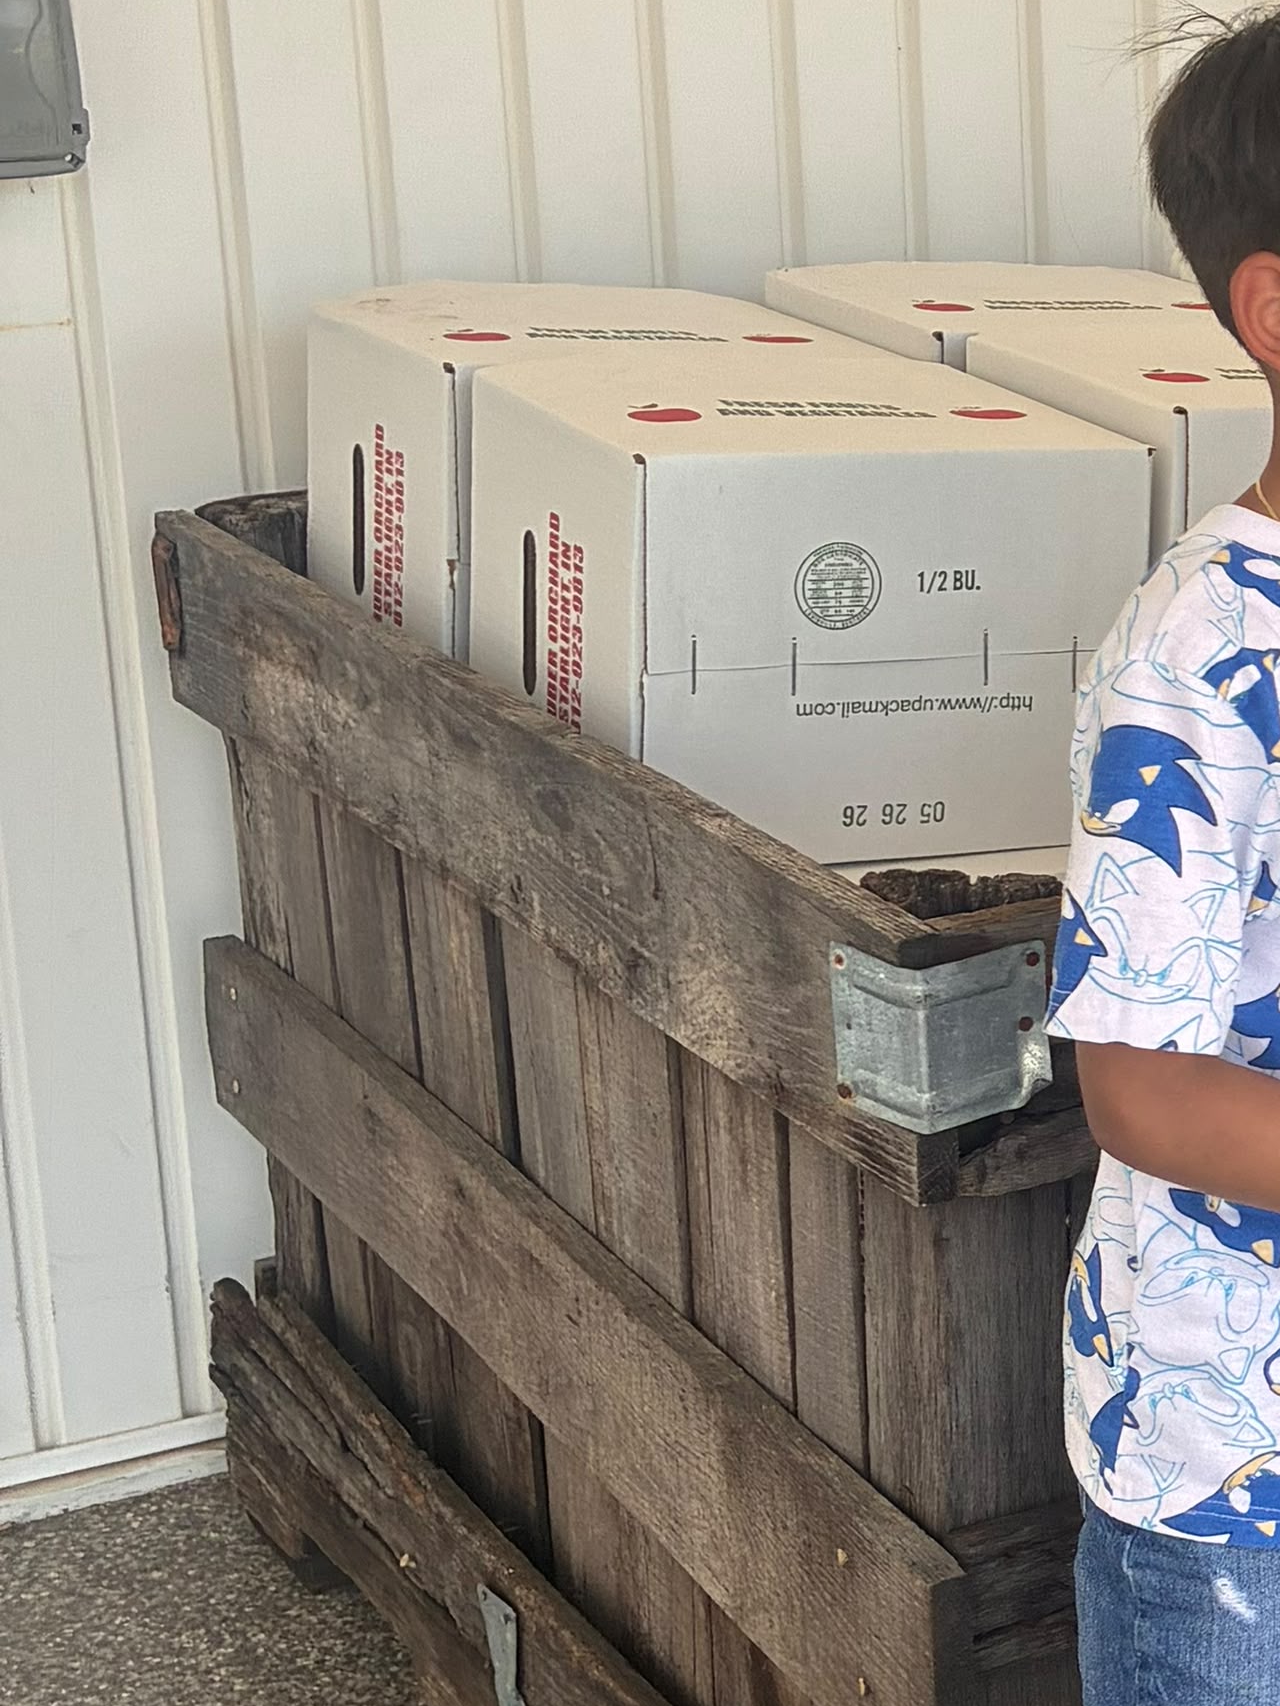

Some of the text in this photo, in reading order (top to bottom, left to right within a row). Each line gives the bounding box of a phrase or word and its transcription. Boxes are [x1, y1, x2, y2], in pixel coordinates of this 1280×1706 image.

[917, 570, 982, 594] 1/2 BU.
[796, 693, 1033, 718] http://www.upackmail.com
[842, 802, 945, 827] 05 26 26
